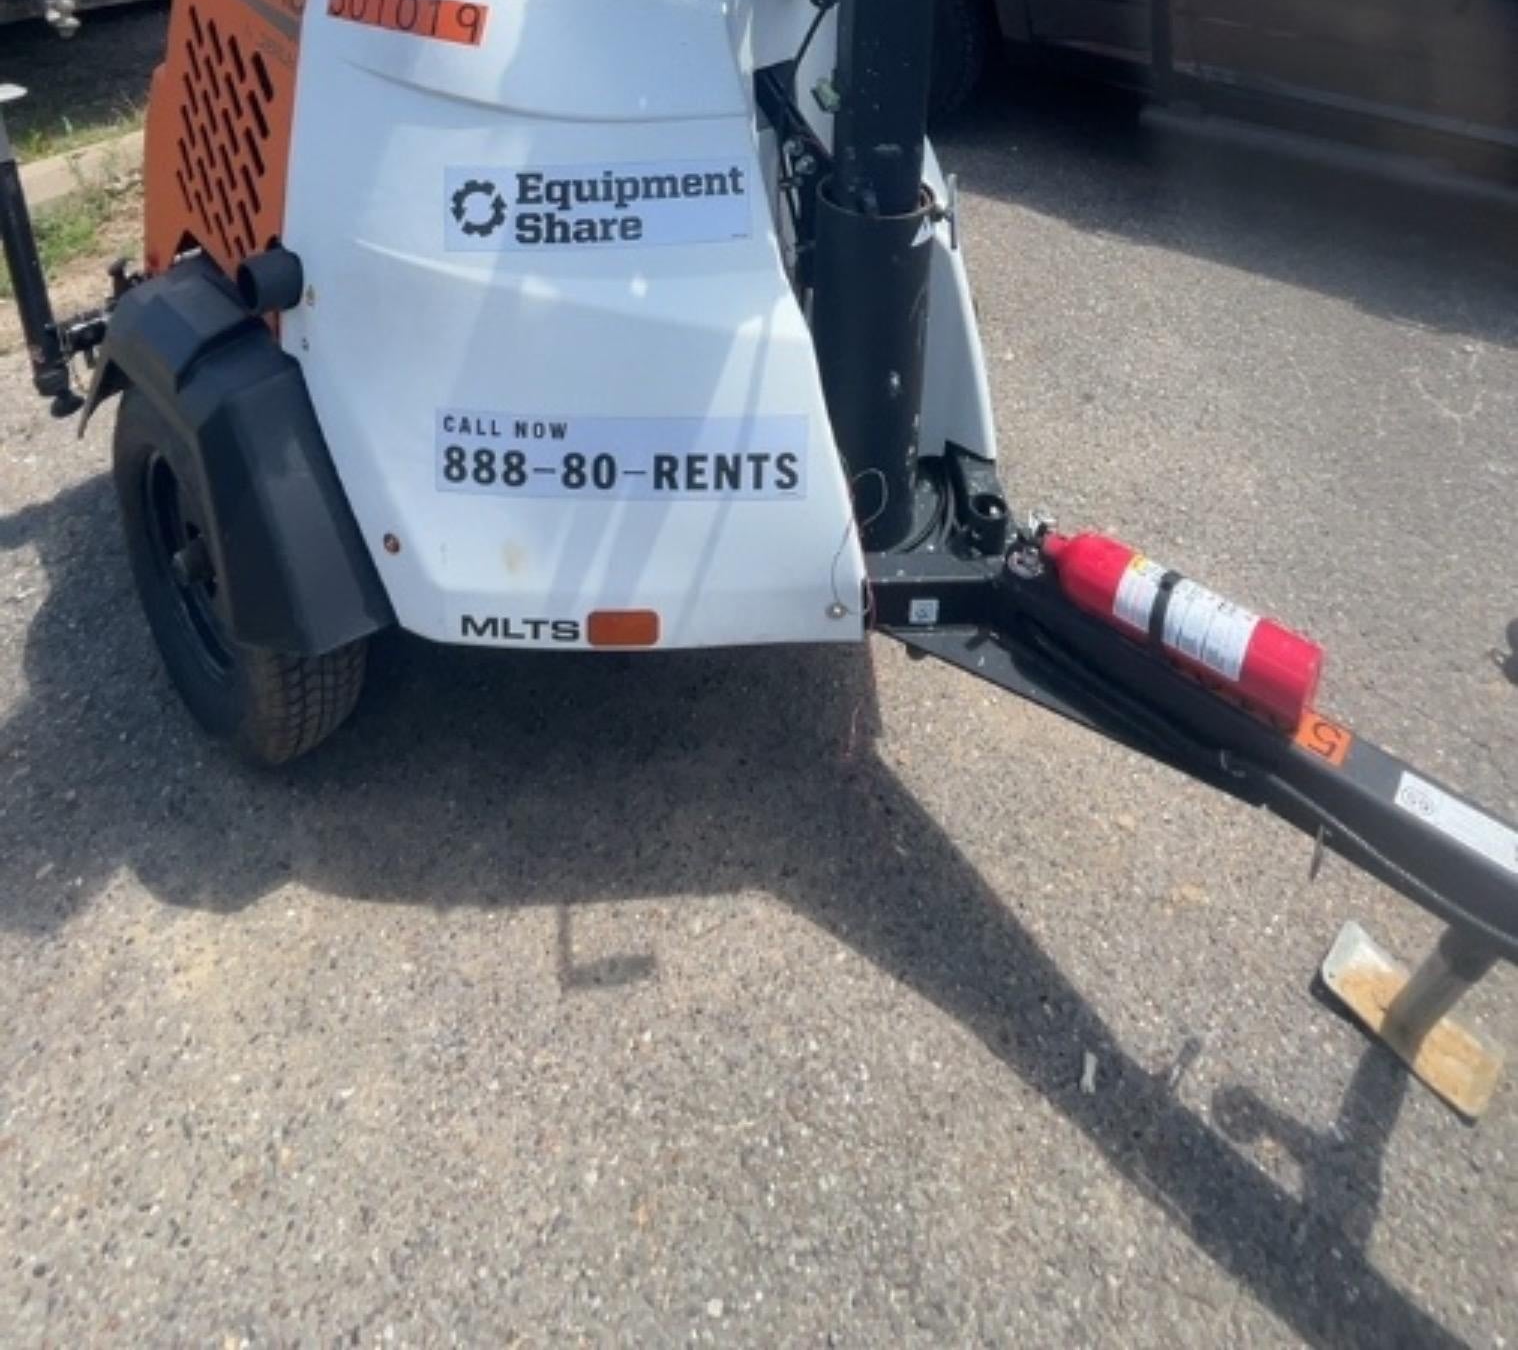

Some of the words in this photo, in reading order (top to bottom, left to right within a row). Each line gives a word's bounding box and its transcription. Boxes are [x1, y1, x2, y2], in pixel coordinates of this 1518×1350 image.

[516, 166, 744, 210] Equipment
[516, 213, 642, 244] Share
[443, 415, 501, 436] CALL
[515, 420, 567, 440] NOW
[461, 615, 580, 642] MLTS
